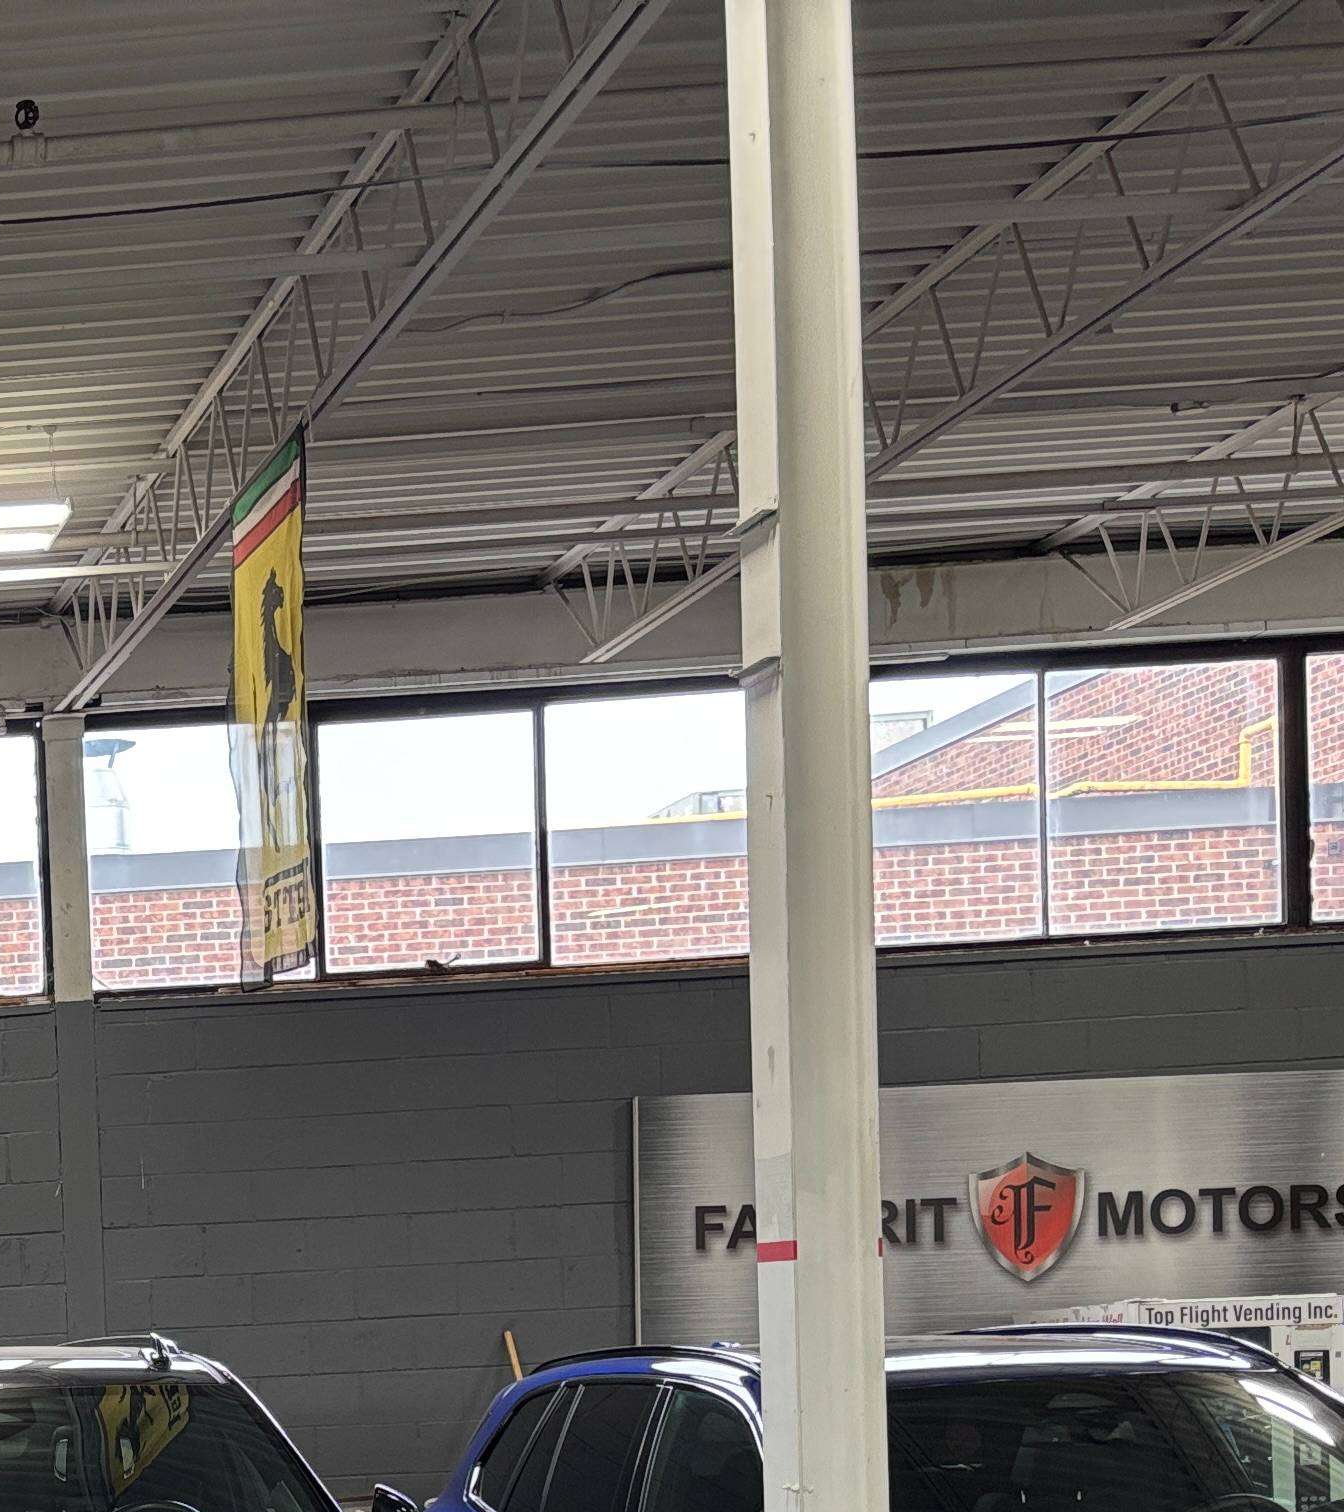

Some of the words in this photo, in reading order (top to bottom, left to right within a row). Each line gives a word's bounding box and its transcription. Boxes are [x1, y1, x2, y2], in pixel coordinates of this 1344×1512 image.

[694, 1197, 958, 1250] FARIT
[1097, 1183, 1344, 1238] MOTOR
[1145, 1307, 1174, 1326] Top
[1180, 1305, 1228, 1327] Flight
[1232, 1303, 1301, 1323] Vending
[1308, 1302, 1338, 1319] Inc.
